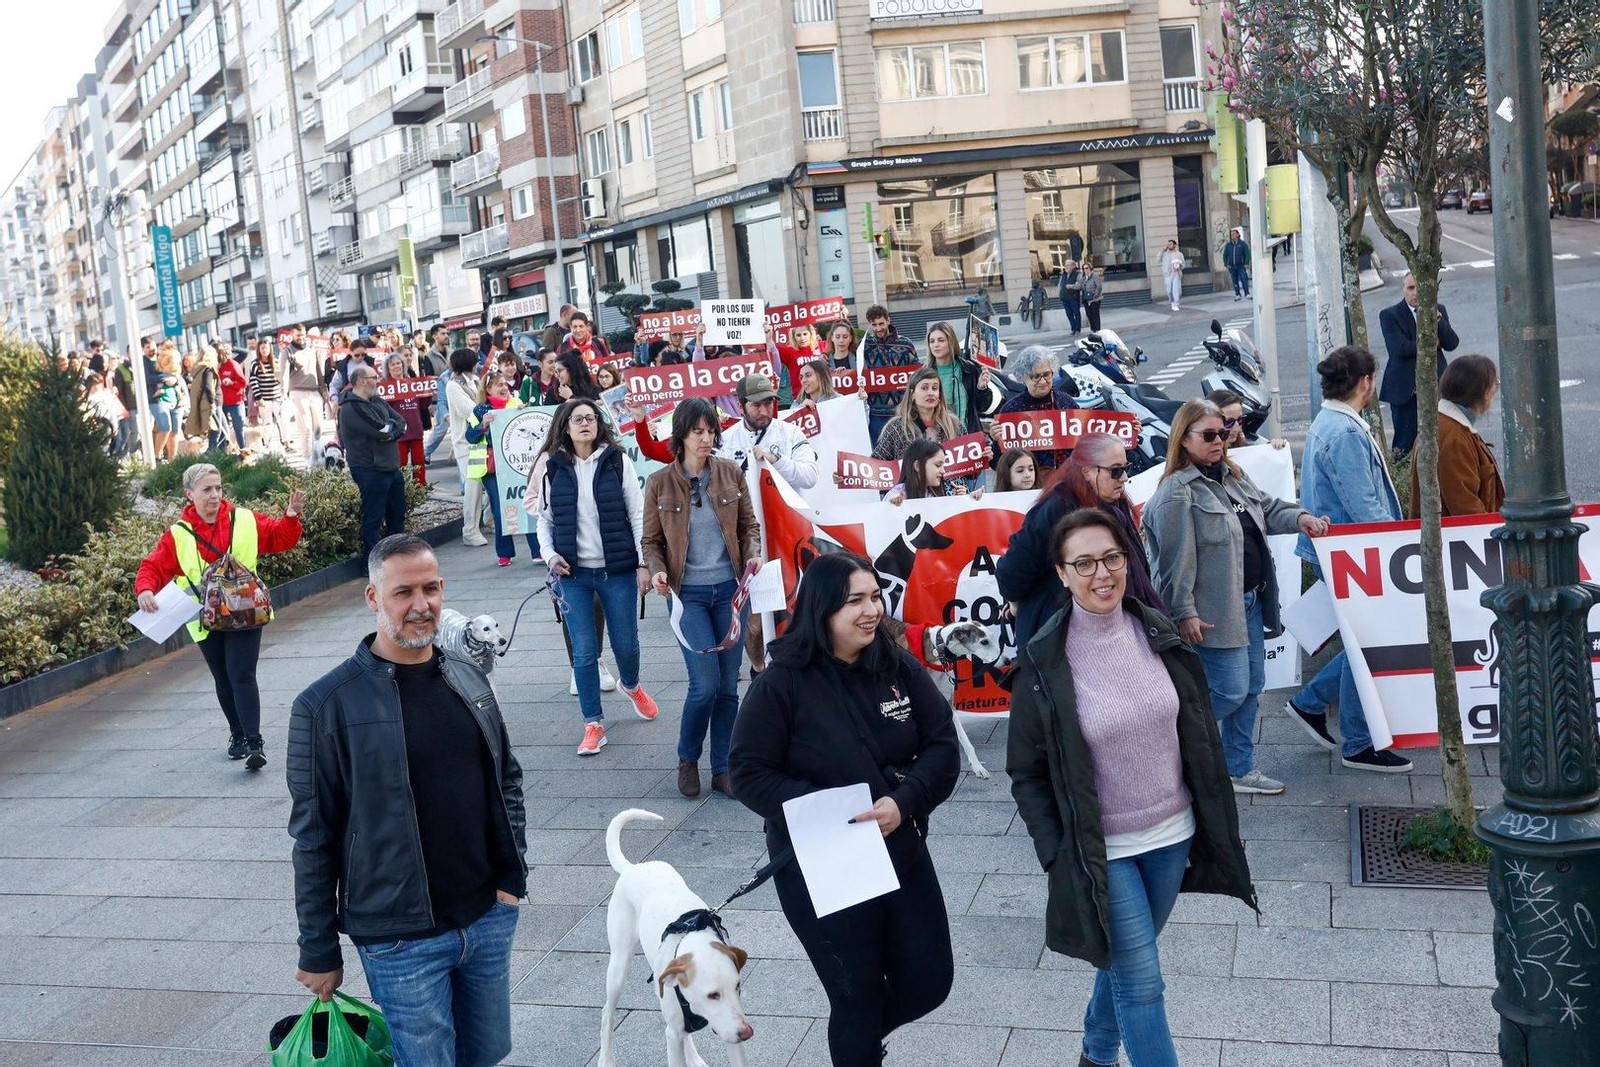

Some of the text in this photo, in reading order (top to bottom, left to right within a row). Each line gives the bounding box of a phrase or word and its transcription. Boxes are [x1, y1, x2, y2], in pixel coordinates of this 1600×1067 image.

[873, 158, 894, 166] Godoy
[895, 156, 922, 165] Maceira
[157, 233, 171, 263] Vigo
[711, 303, 755, 314] POR LOS QUE
[764, 312, 780, 325] no
[783, 310, 792, 321] a
[793, 304, 808, 320] la
[810, 301, 841, 317] caza
[643, 312, 701, 328] no a la ca
[716, 317, 751, 327] NO TIENEN
[726, 330, 742, 340] VOZ!
[775, 330, 787, 344] la
[629, 373, 663, 394] no
[668, 370, 684, 390] a
[687, 363, 713, 388] la
[717, 359, 774, 384] caza
[831, 375, 853, 388] no
[857, 374, 867, 387] a
[869, 370, 886, 386] la
[387, 384, 395, 395] a
[396, 379, 409, 394] la
[410, 379, 438, 392] caza
[632, 389, 684, 403] con perros
[1000, 411, 1133, 440] no a la caza
[1003, 438, 1054, 450] con perros
[508, 453, 520, 465] Os
[843, 441, 983, 481] no a aza
[843, 476, 861, 486] con
[862, 479, 894, 488] perros
